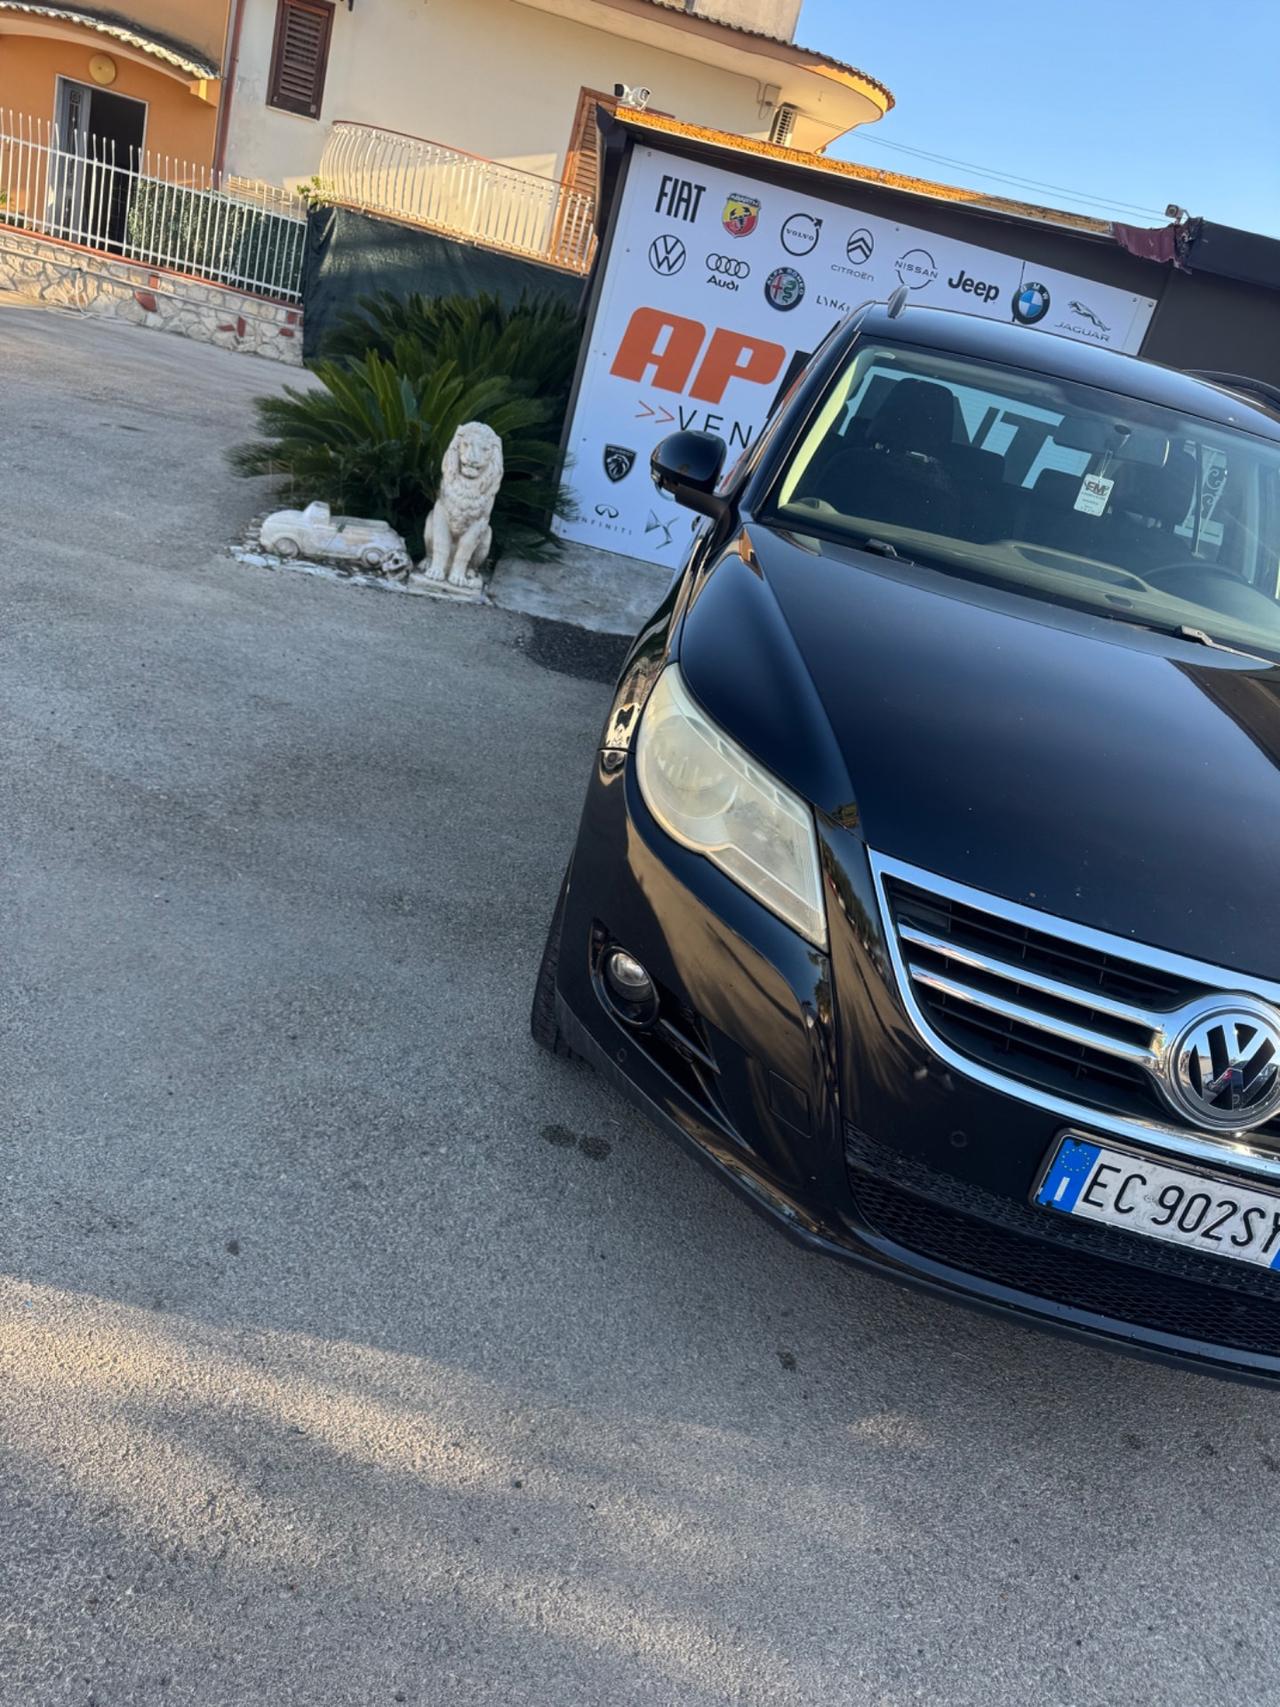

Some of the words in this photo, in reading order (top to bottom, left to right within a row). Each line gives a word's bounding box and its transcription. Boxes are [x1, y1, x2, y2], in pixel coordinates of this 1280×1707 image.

[655, 175, 706, 223] FIAT
[786, 228, 815, 241] VOLVO
[894, 260, 938, 279] NISSAN
[706, 275, 739, 292] Audi
[948, 270, 1000, 303] Jeep
[1054, 322, 1110, 342] JAGUAR
[678, 405, 752, 449] VEN
[1082, 1163, 1147, 1214] EC
